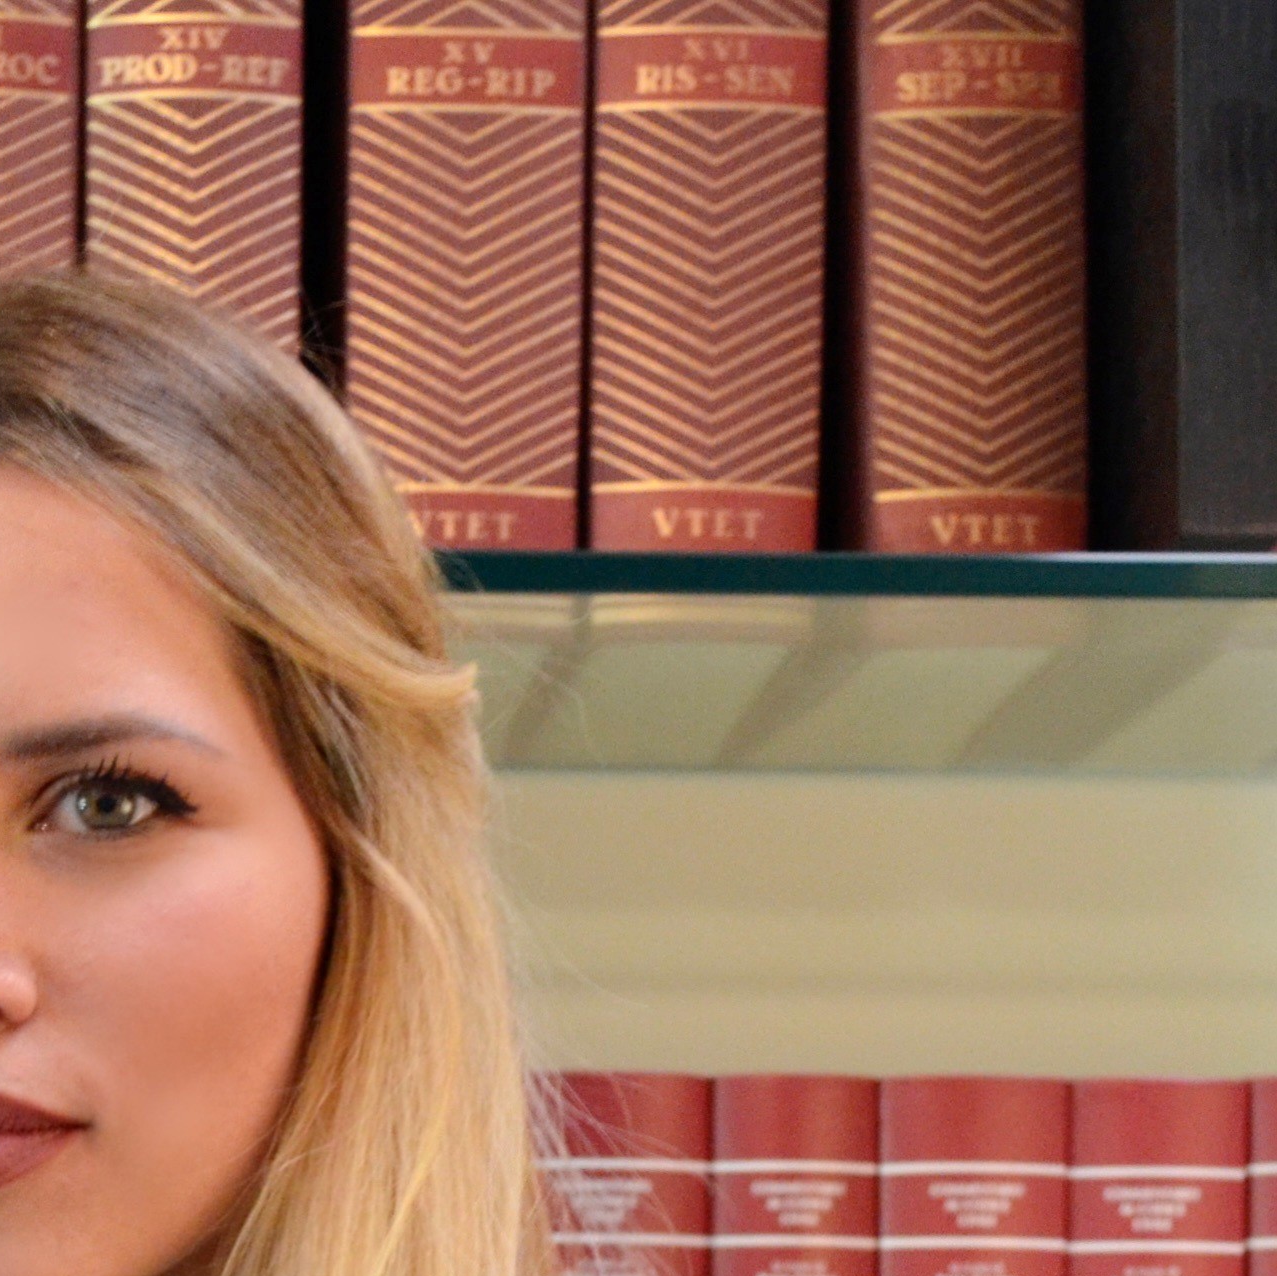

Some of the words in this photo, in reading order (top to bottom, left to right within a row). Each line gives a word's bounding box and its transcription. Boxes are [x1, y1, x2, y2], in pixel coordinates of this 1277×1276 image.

[161, 26, 229, 50] XIV
[684, 38, 750, 62] XVI
[442, 41, 496, 64] XV
[941, 45, 1023, 68] XVII
[385, 65, 557, 98] REG-RIP
[653, 507, 762, 539] VTET
[930, 514, 1040, 544] VTET
